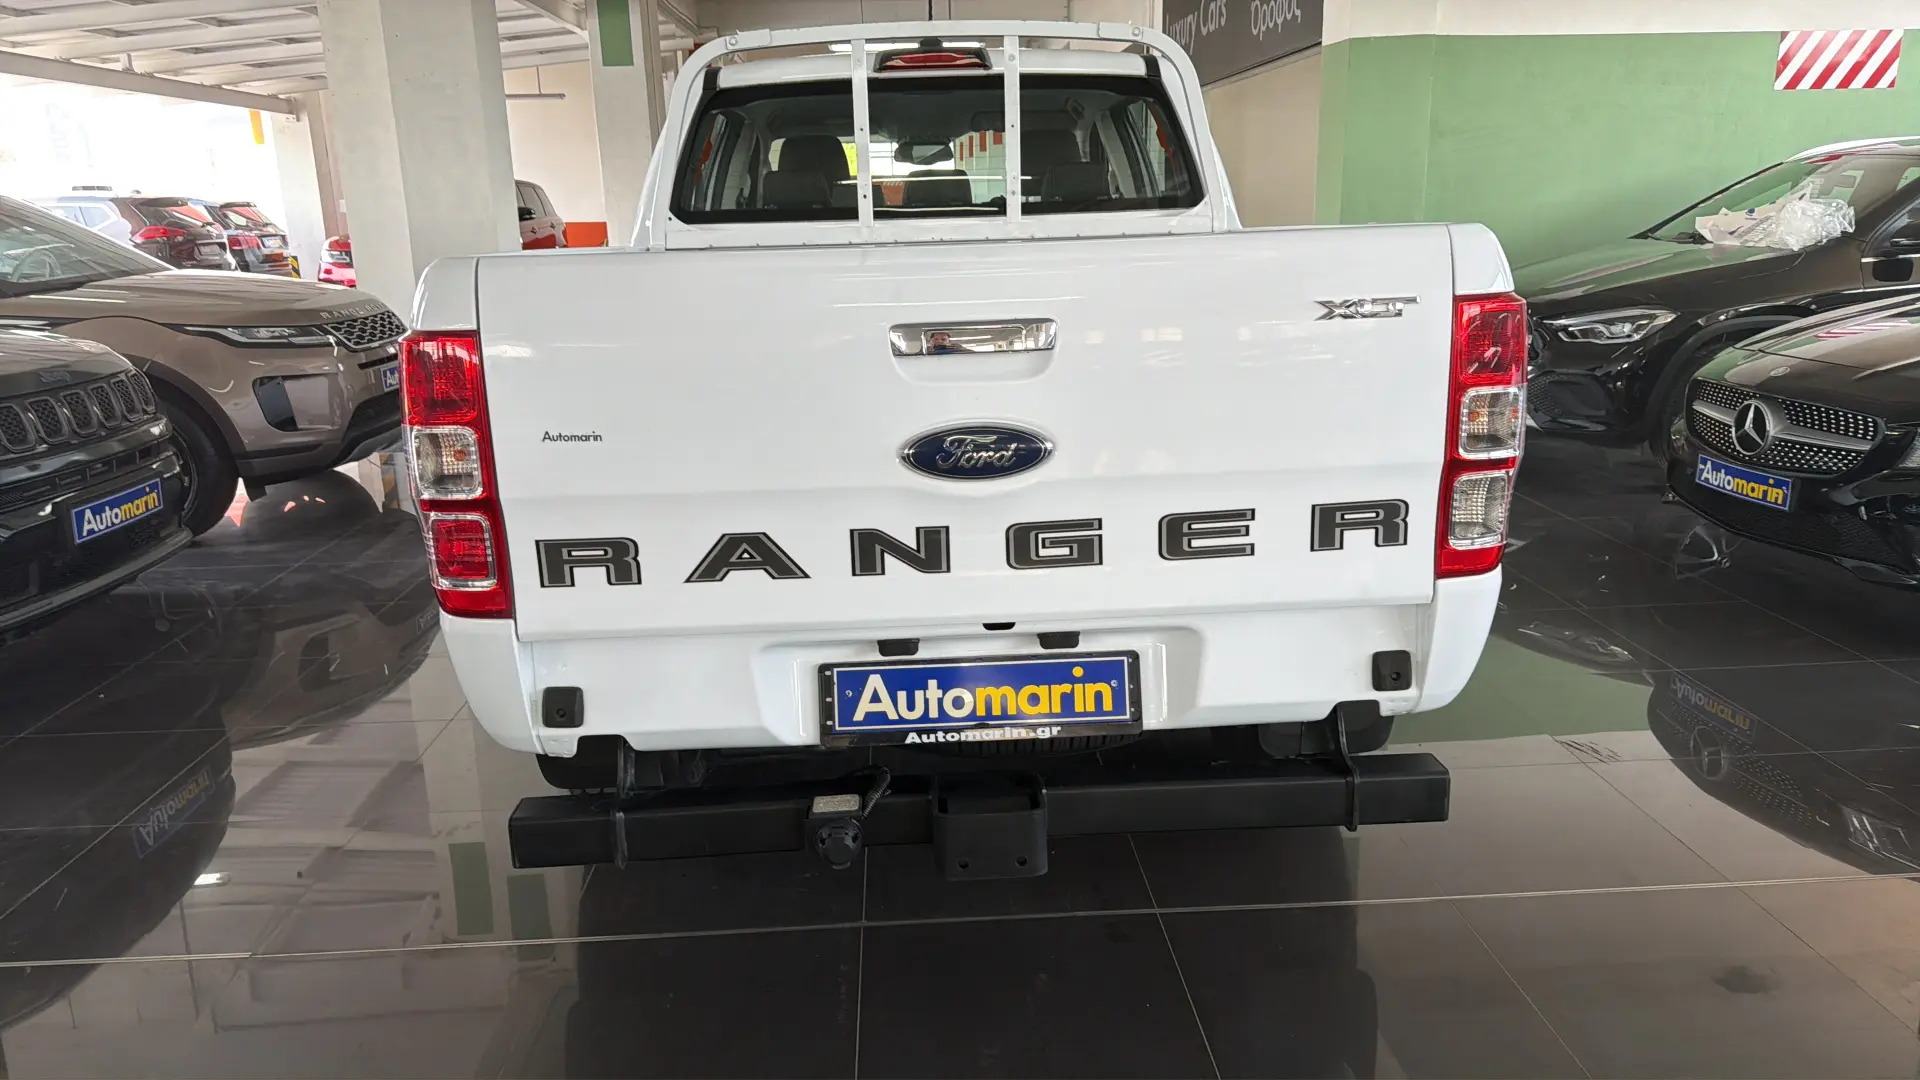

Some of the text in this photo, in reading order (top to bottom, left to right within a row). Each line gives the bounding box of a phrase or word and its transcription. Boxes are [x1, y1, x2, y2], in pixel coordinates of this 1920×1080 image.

[1200, 0, 1227, 36] Cars
[1313, 295, 1421, 321] XLT
[542, 430, 603, 442] Automarin
[936, 435, 1018, 468] Ford
[1701, 460, 1785, 505] Automarin
[82, 486, 159, 536] Automarin
[535, 499, 1409, 588] RANGER
[852, 666, 1113, 722] Automarin
[904, 725, 1062, 744] Automarin.gr
